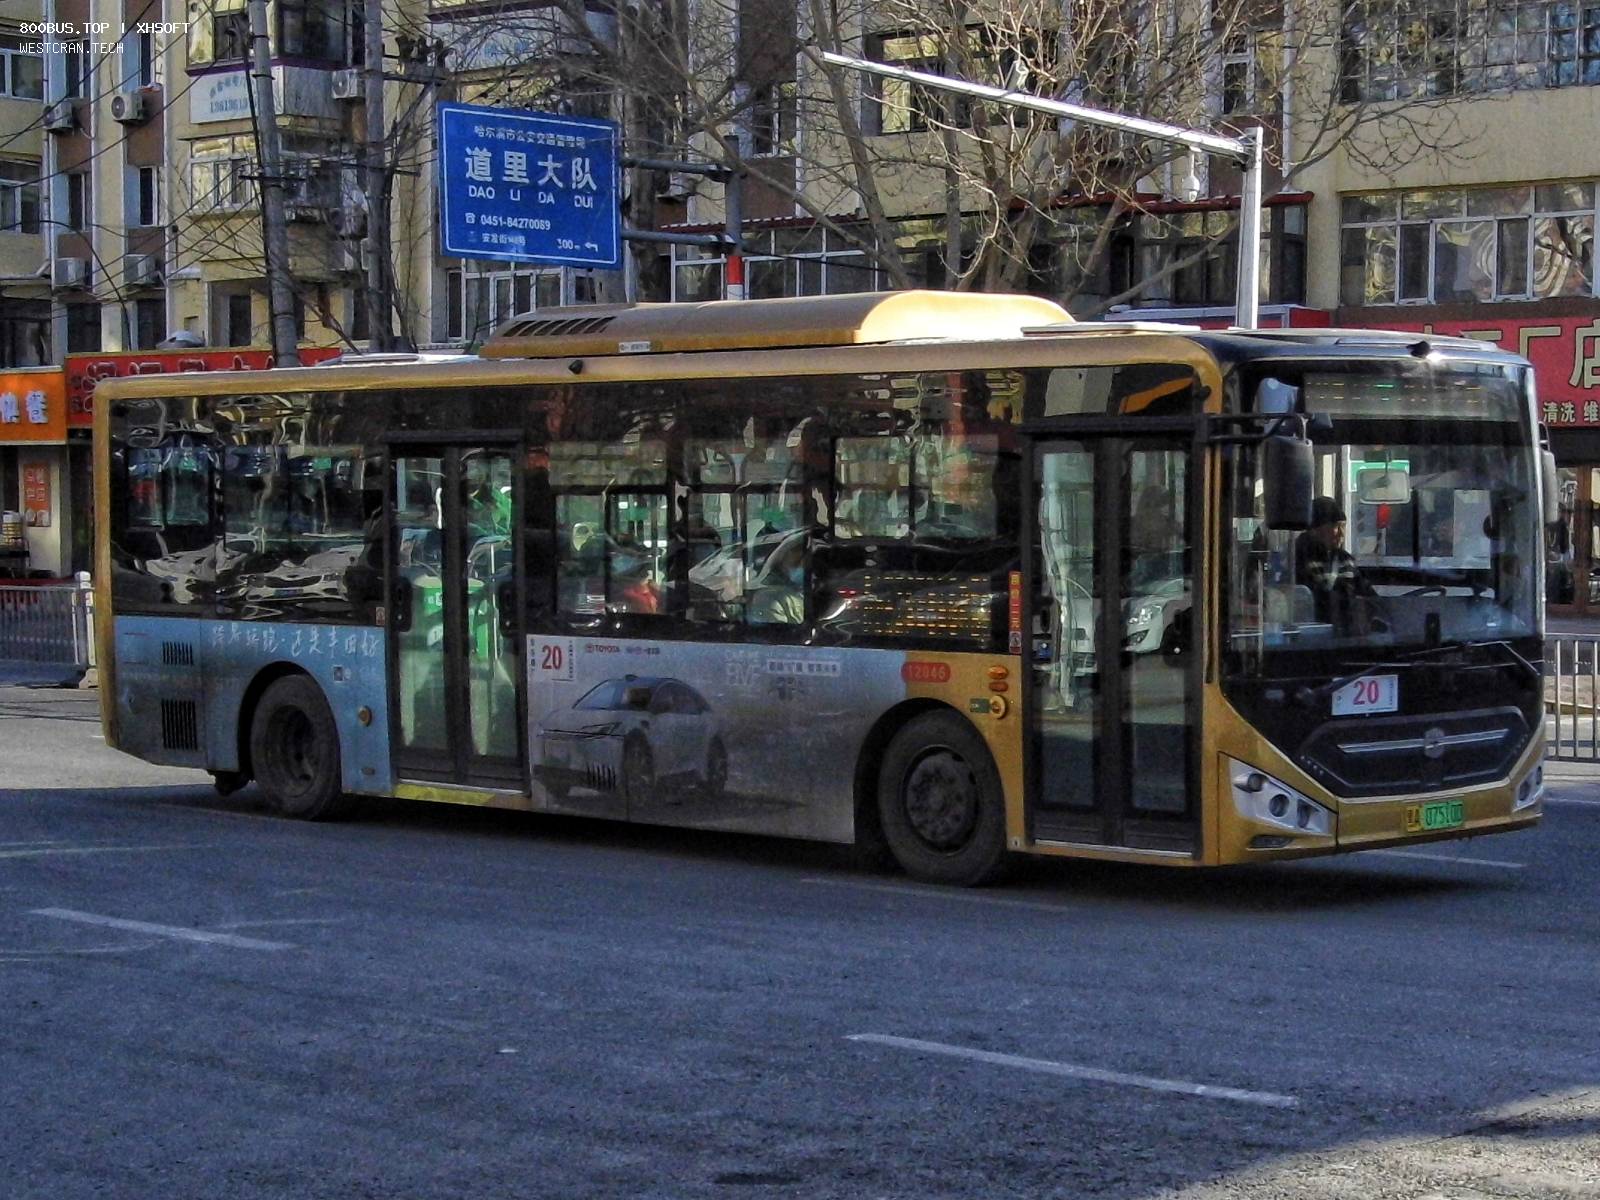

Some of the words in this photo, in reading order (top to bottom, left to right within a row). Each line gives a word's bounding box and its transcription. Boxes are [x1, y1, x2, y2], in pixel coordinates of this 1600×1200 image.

[465, 146, 597, 191] 道里大队
[468, 185, 496, 200] DAO
[510, 188, 521, 201] LI
[538, 191, 555, 205] DA
[574, 195, 593, 209] DUI
[1542, 401, 1576, 423] 清洗
[542, 644, 563, 670] 20
[595, 644, 620, 653] TOYOTA
[1352, 679, 1379, 705] 20
